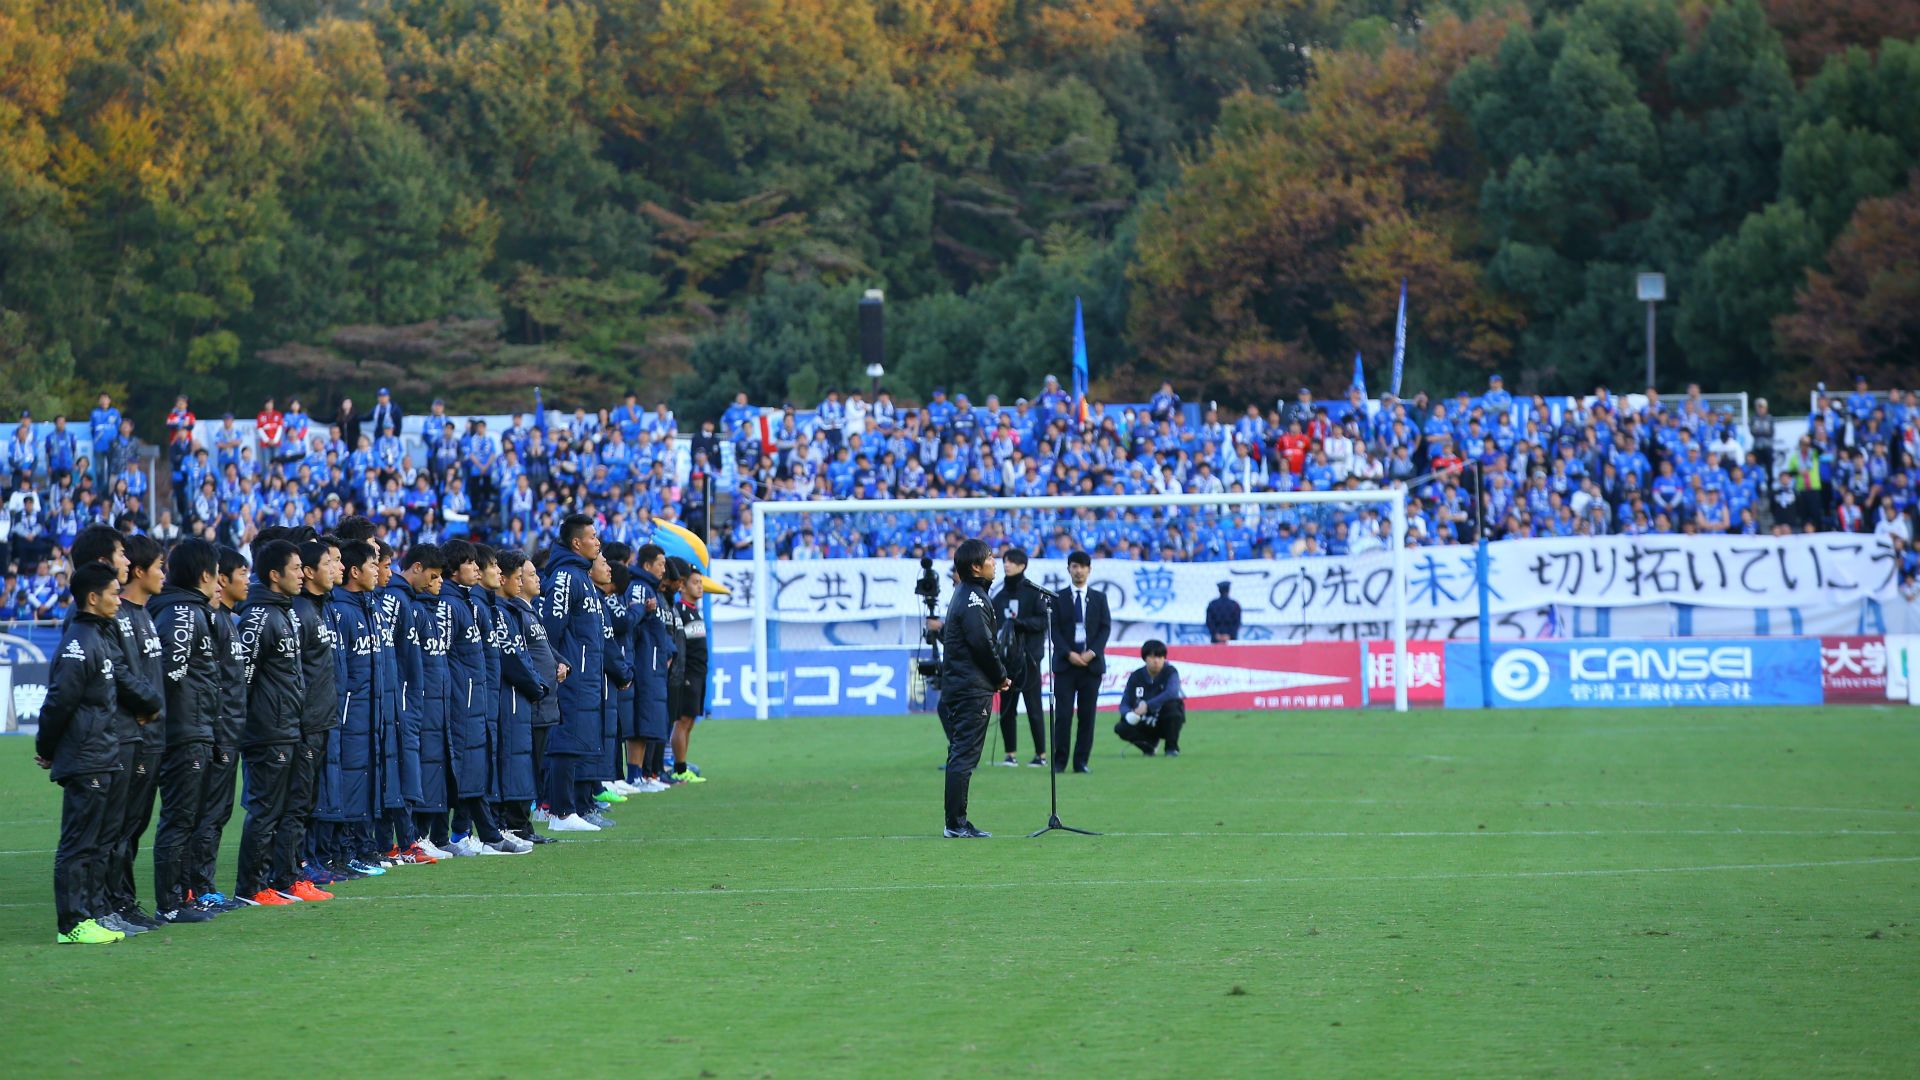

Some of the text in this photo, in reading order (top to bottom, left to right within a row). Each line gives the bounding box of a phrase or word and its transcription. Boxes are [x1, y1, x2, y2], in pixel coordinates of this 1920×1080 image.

[553, 571, 567, 619] SVOLME
[172, 605, 189, 663] SVOLME
[239, 606, 266, 664] SVOLME
[1369, 652, 1442, 688] 相模
[1570, 646, 1752, 680] KANSEI
[1820, 642, 1886, 675] 大学
